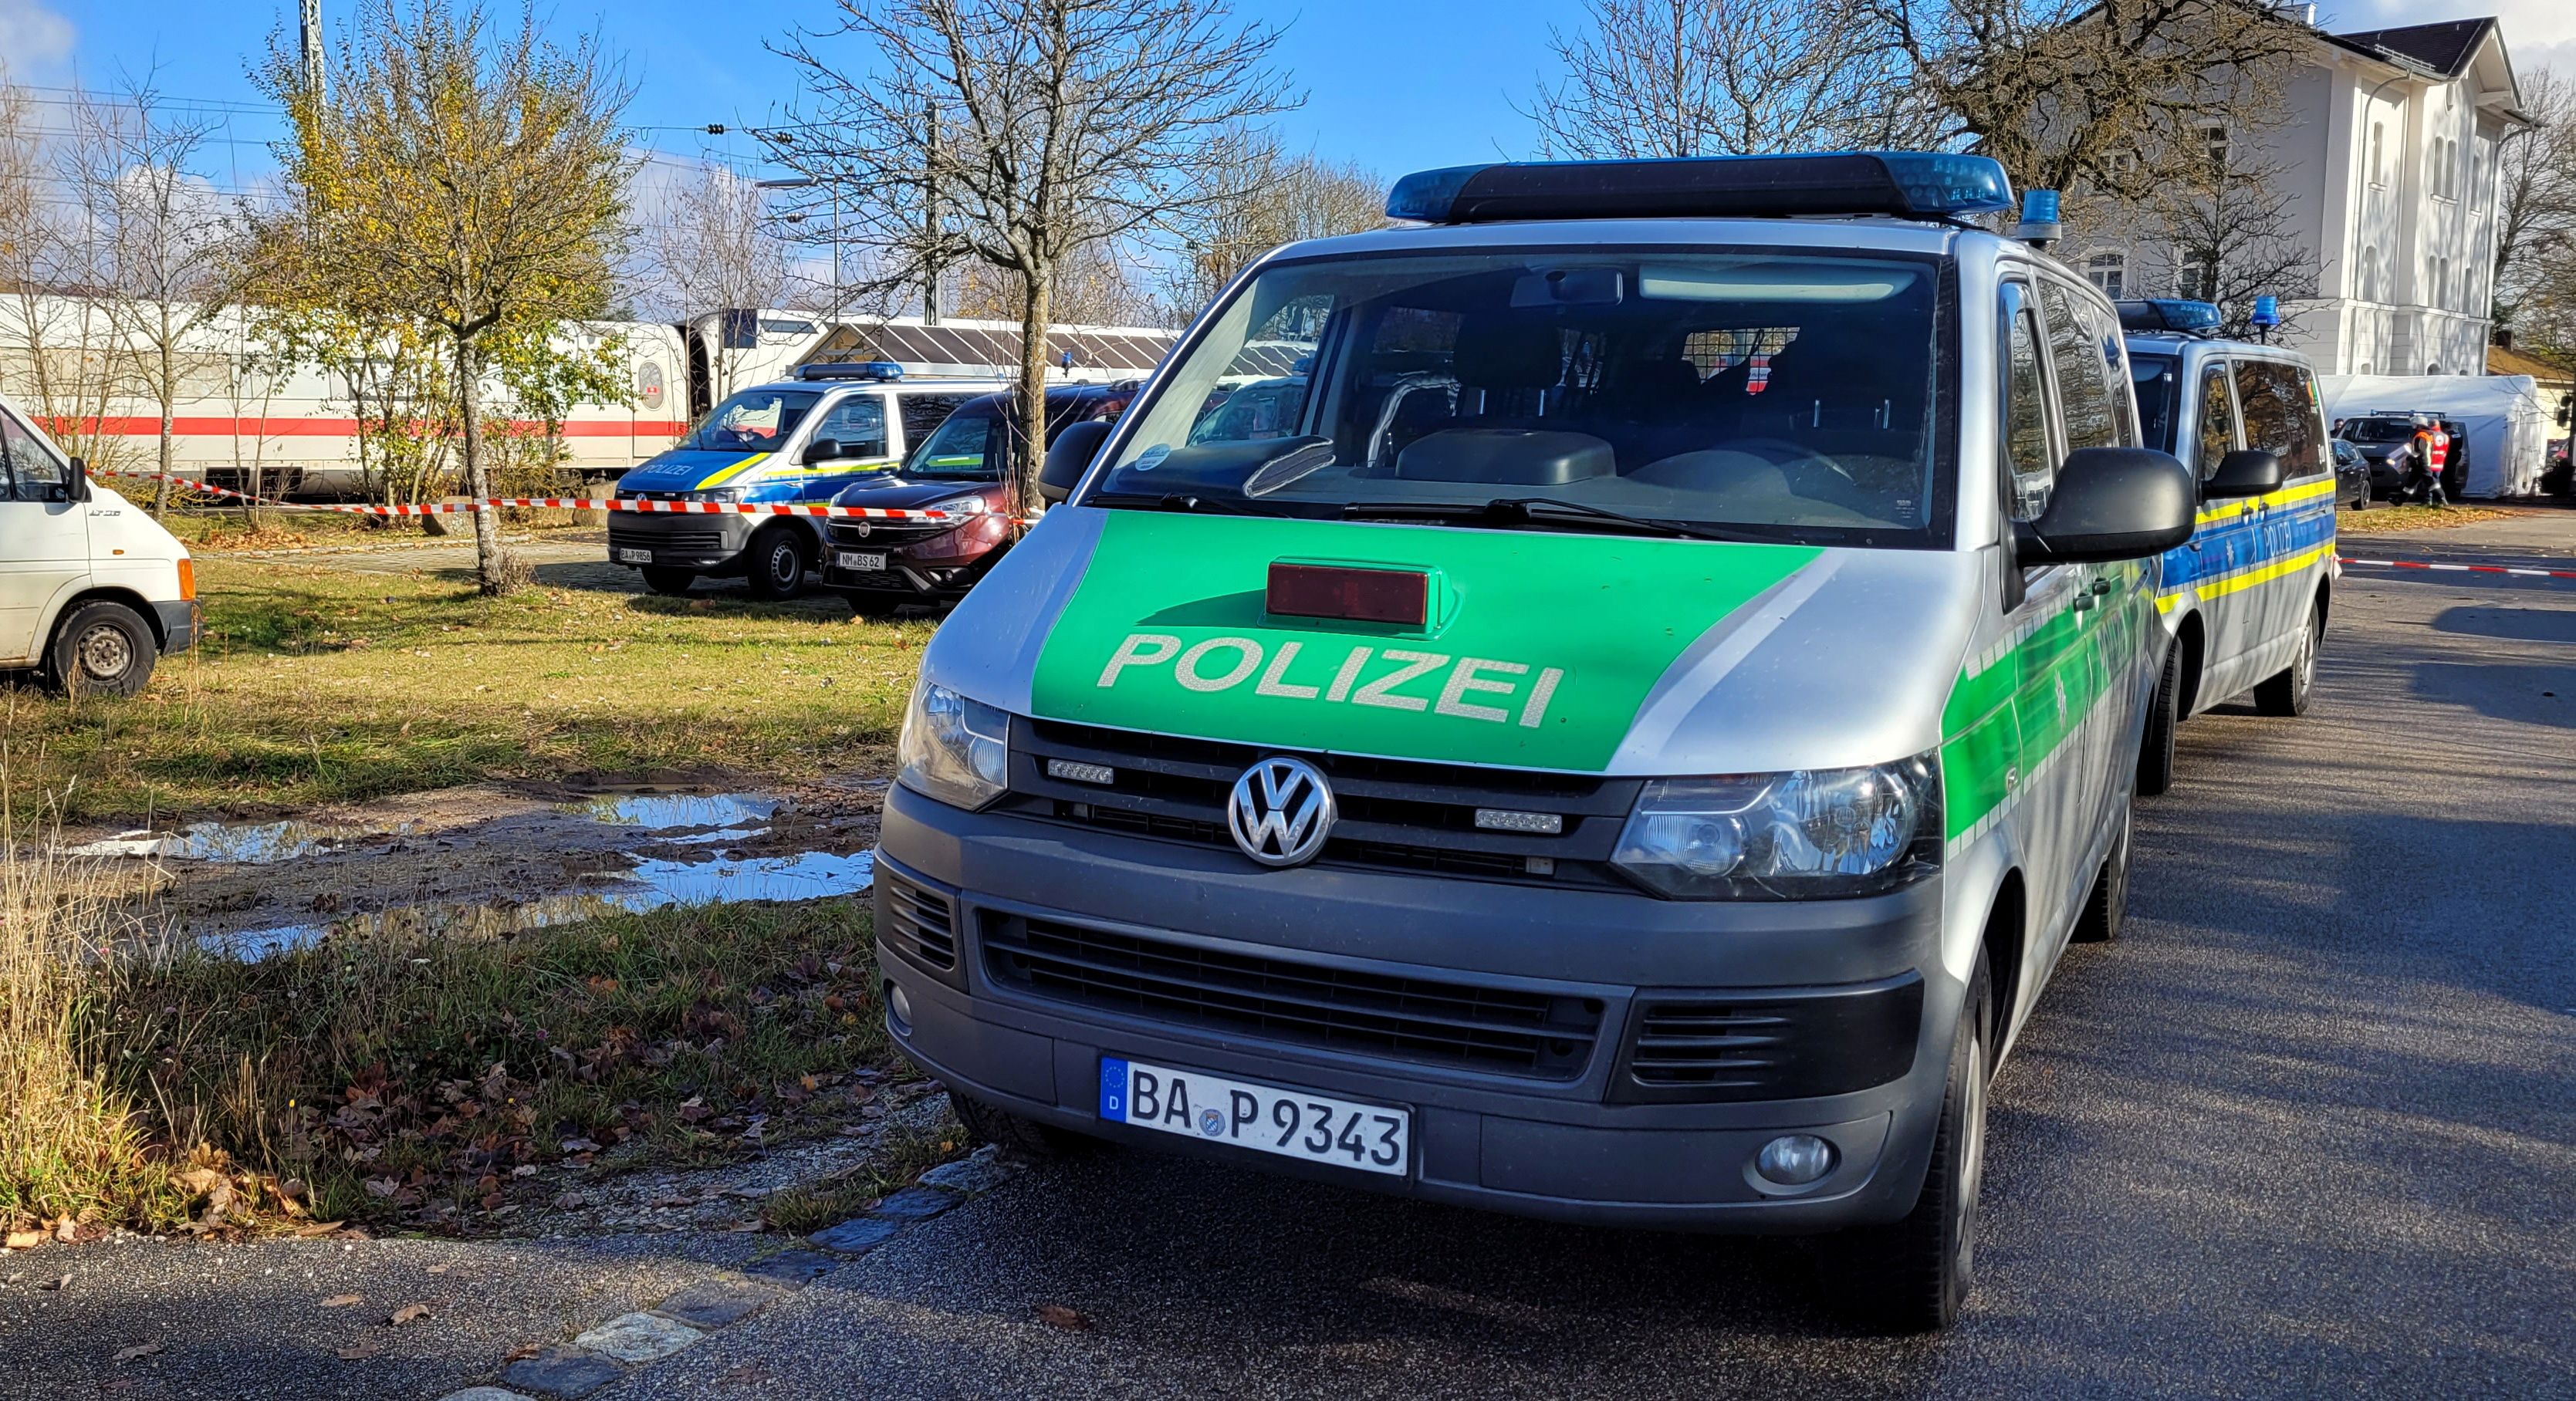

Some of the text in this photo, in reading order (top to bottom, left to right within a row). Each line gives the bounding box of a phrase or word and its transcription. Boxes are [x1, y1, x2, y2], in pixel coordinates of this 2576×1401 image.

[639, 464, 694, 475] POLIZEI
[2263, 519, 2291, 559] POLIZEI
[1096, 633, 1564, 728] POLIZEI
[1109, 1095, 1119, 1110] D
[1131, 1069, 1192, 1129] BA
[1273, 1099, 1401, 1166] 9343
